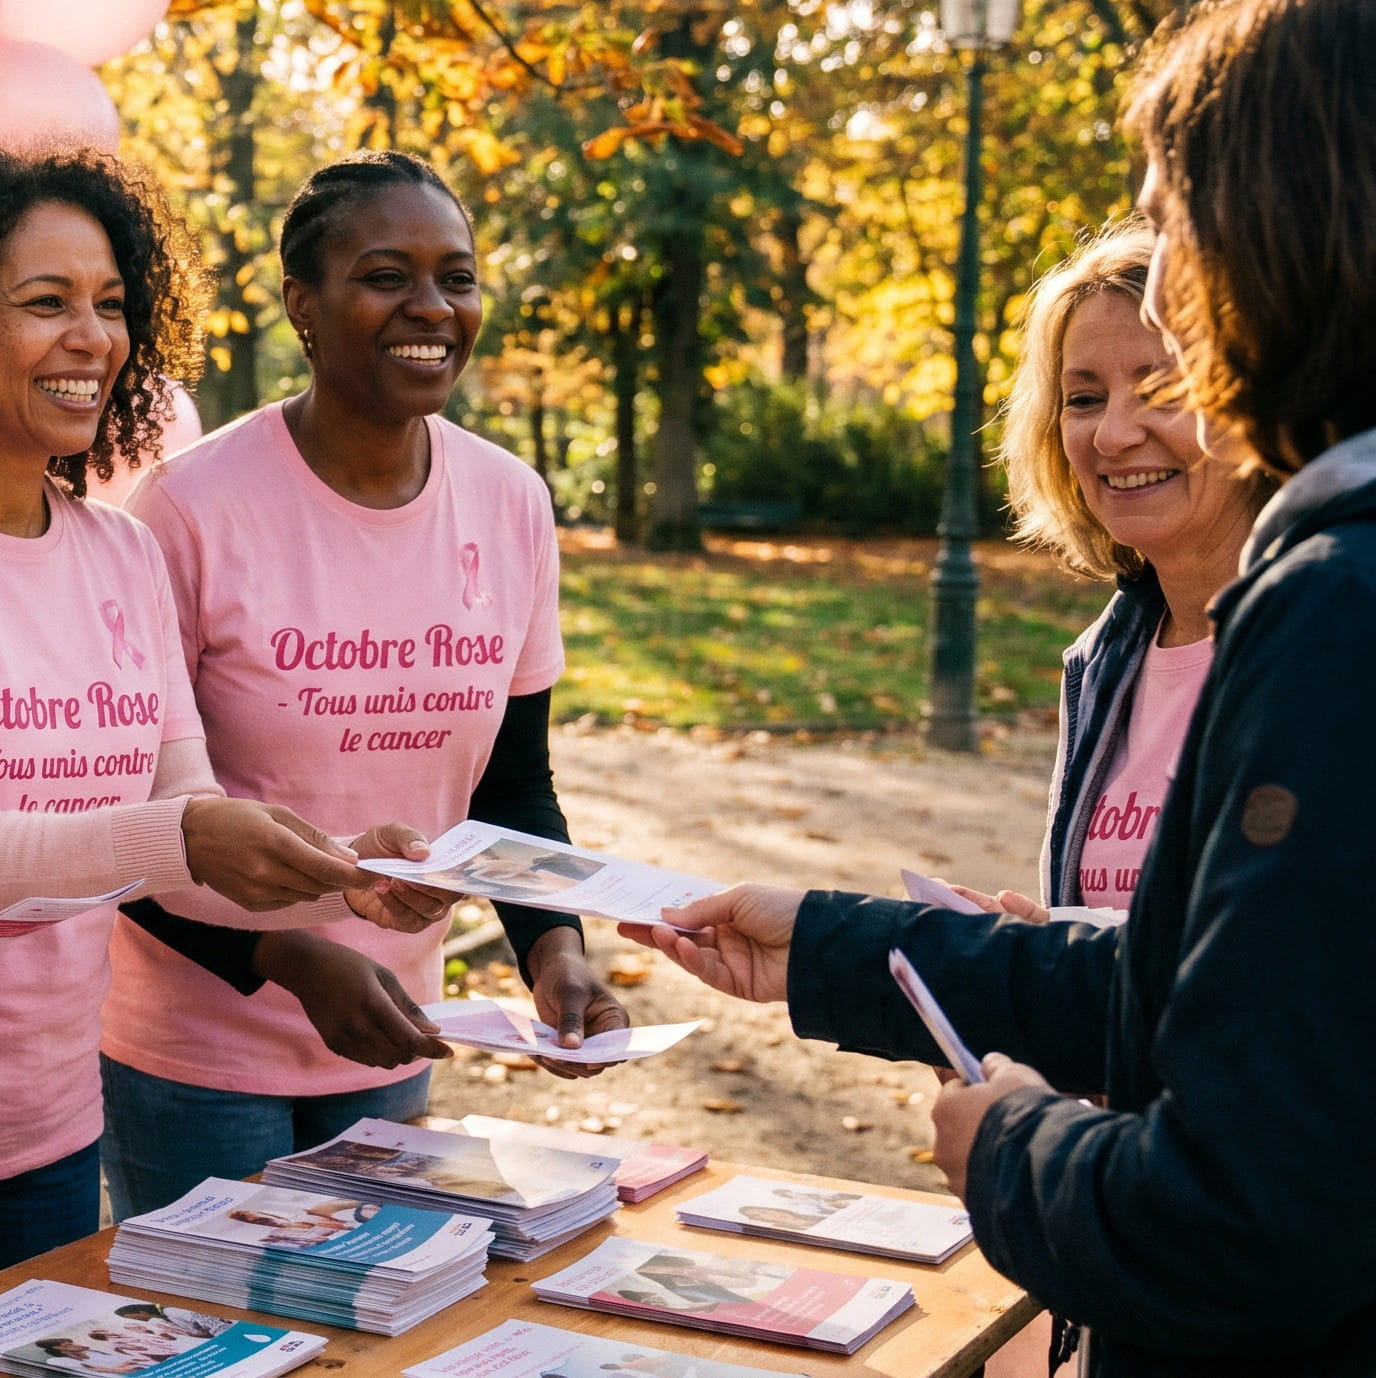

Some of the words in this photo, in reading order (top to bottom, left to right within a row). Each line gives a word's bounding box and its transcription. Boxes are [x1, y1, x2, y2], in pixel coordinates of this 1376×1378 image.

[270, 627, 416, 671] Octobre
[424, 623, 504, 668] Rose
[87, 681, 160, 729] Rose
[298, 687, 357, 716] Tous
[364, 686, 416, 714] unis
[423, 685, 494, 712] contre
[339, 728, 362, 752] le
[367, 729, 452, 751] cancer
[41, 749, 88, 779] unis
[93, 747, 154, 777] contre
[1088, 791, 1161, 841] tobr
[1079, 868, 1108, 892] ous
